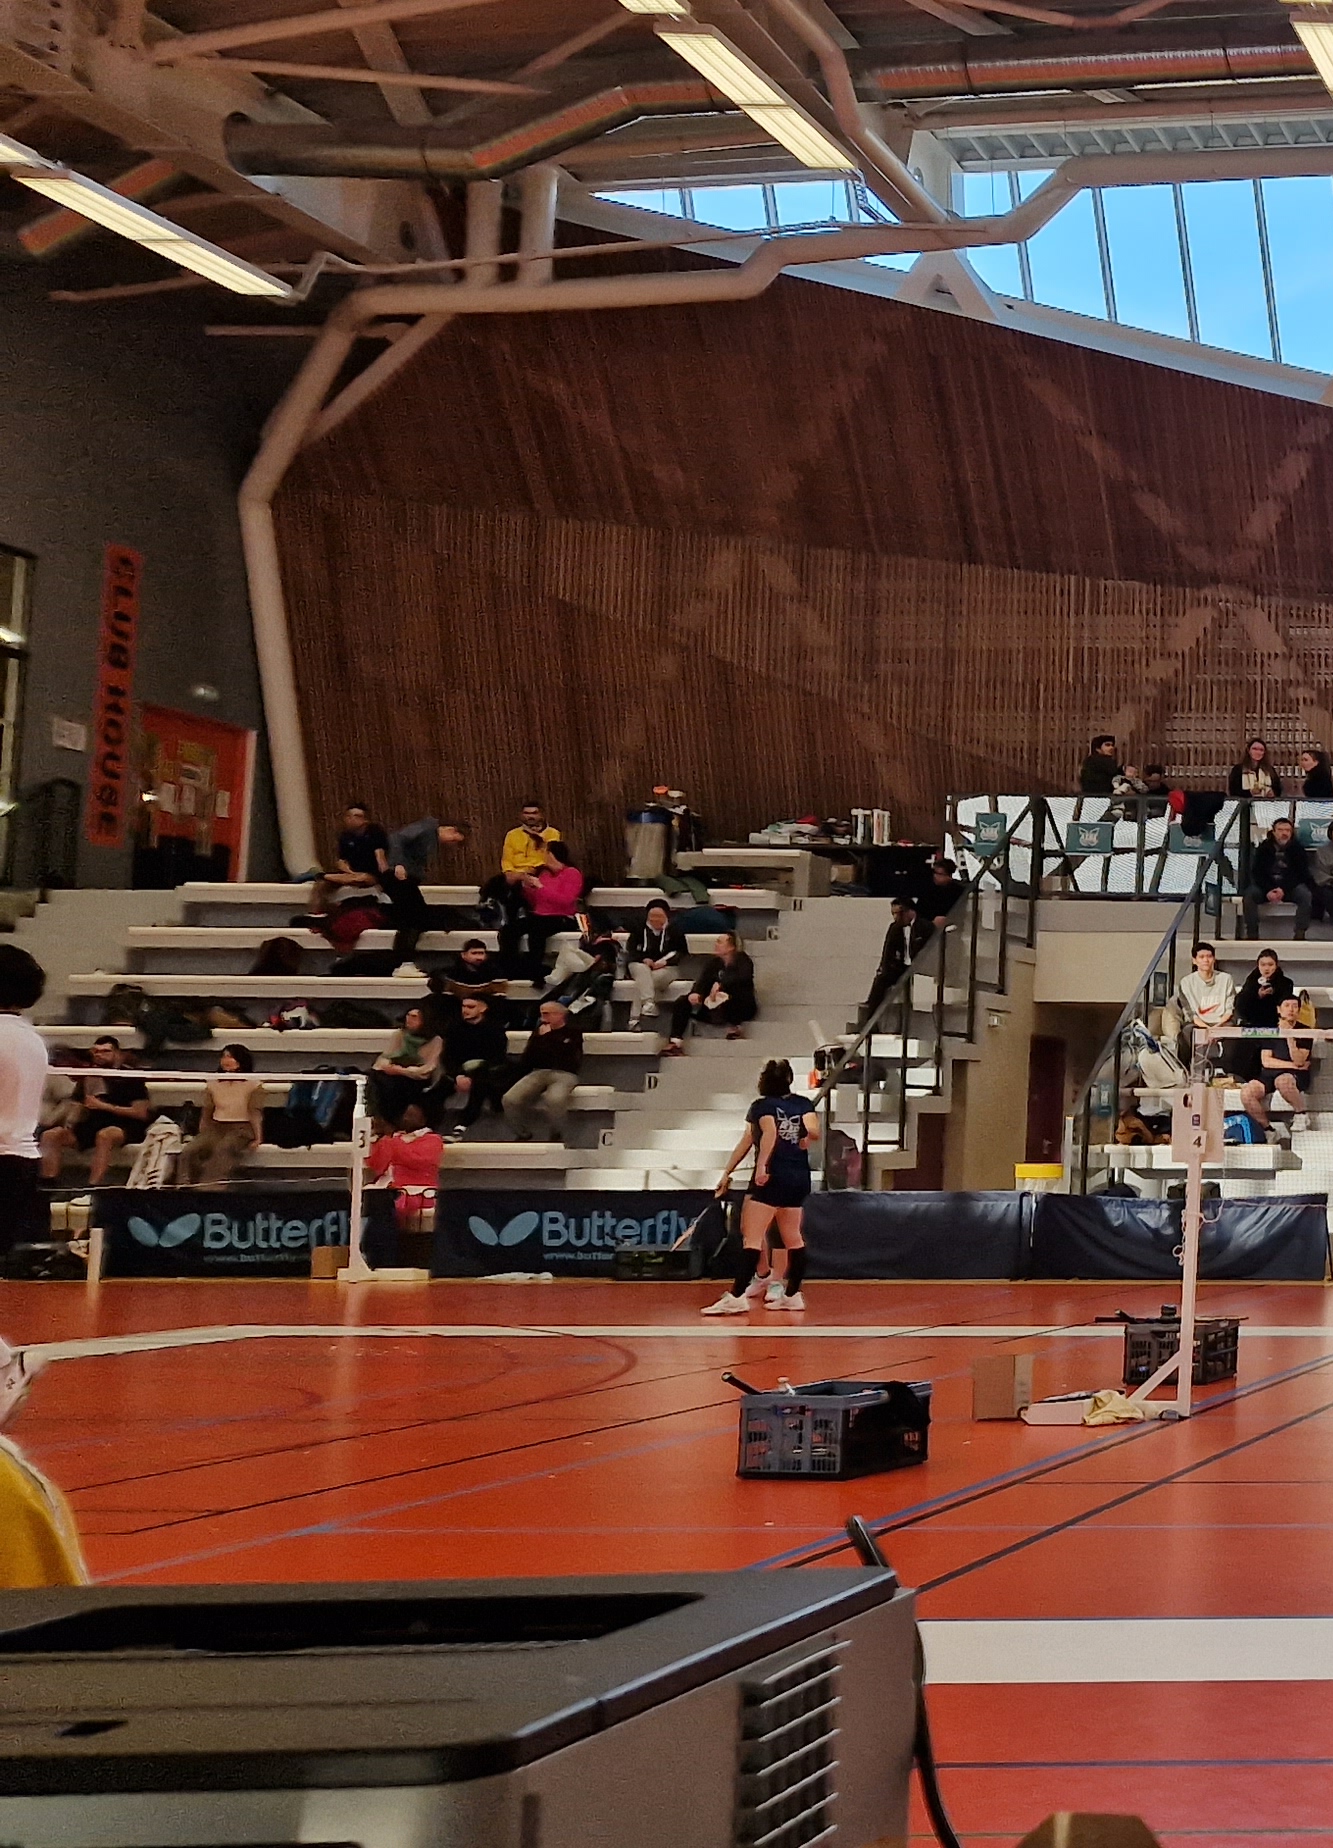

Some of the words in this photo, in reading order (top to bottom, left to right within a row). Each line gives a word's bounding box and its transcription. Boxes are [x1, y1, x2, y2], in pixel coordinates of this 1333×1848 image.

[107, 555, 136, 670] CLUB
[100, 684, 127, 838] HOUSE
[1192, 1135, 1202, 1148] 4
